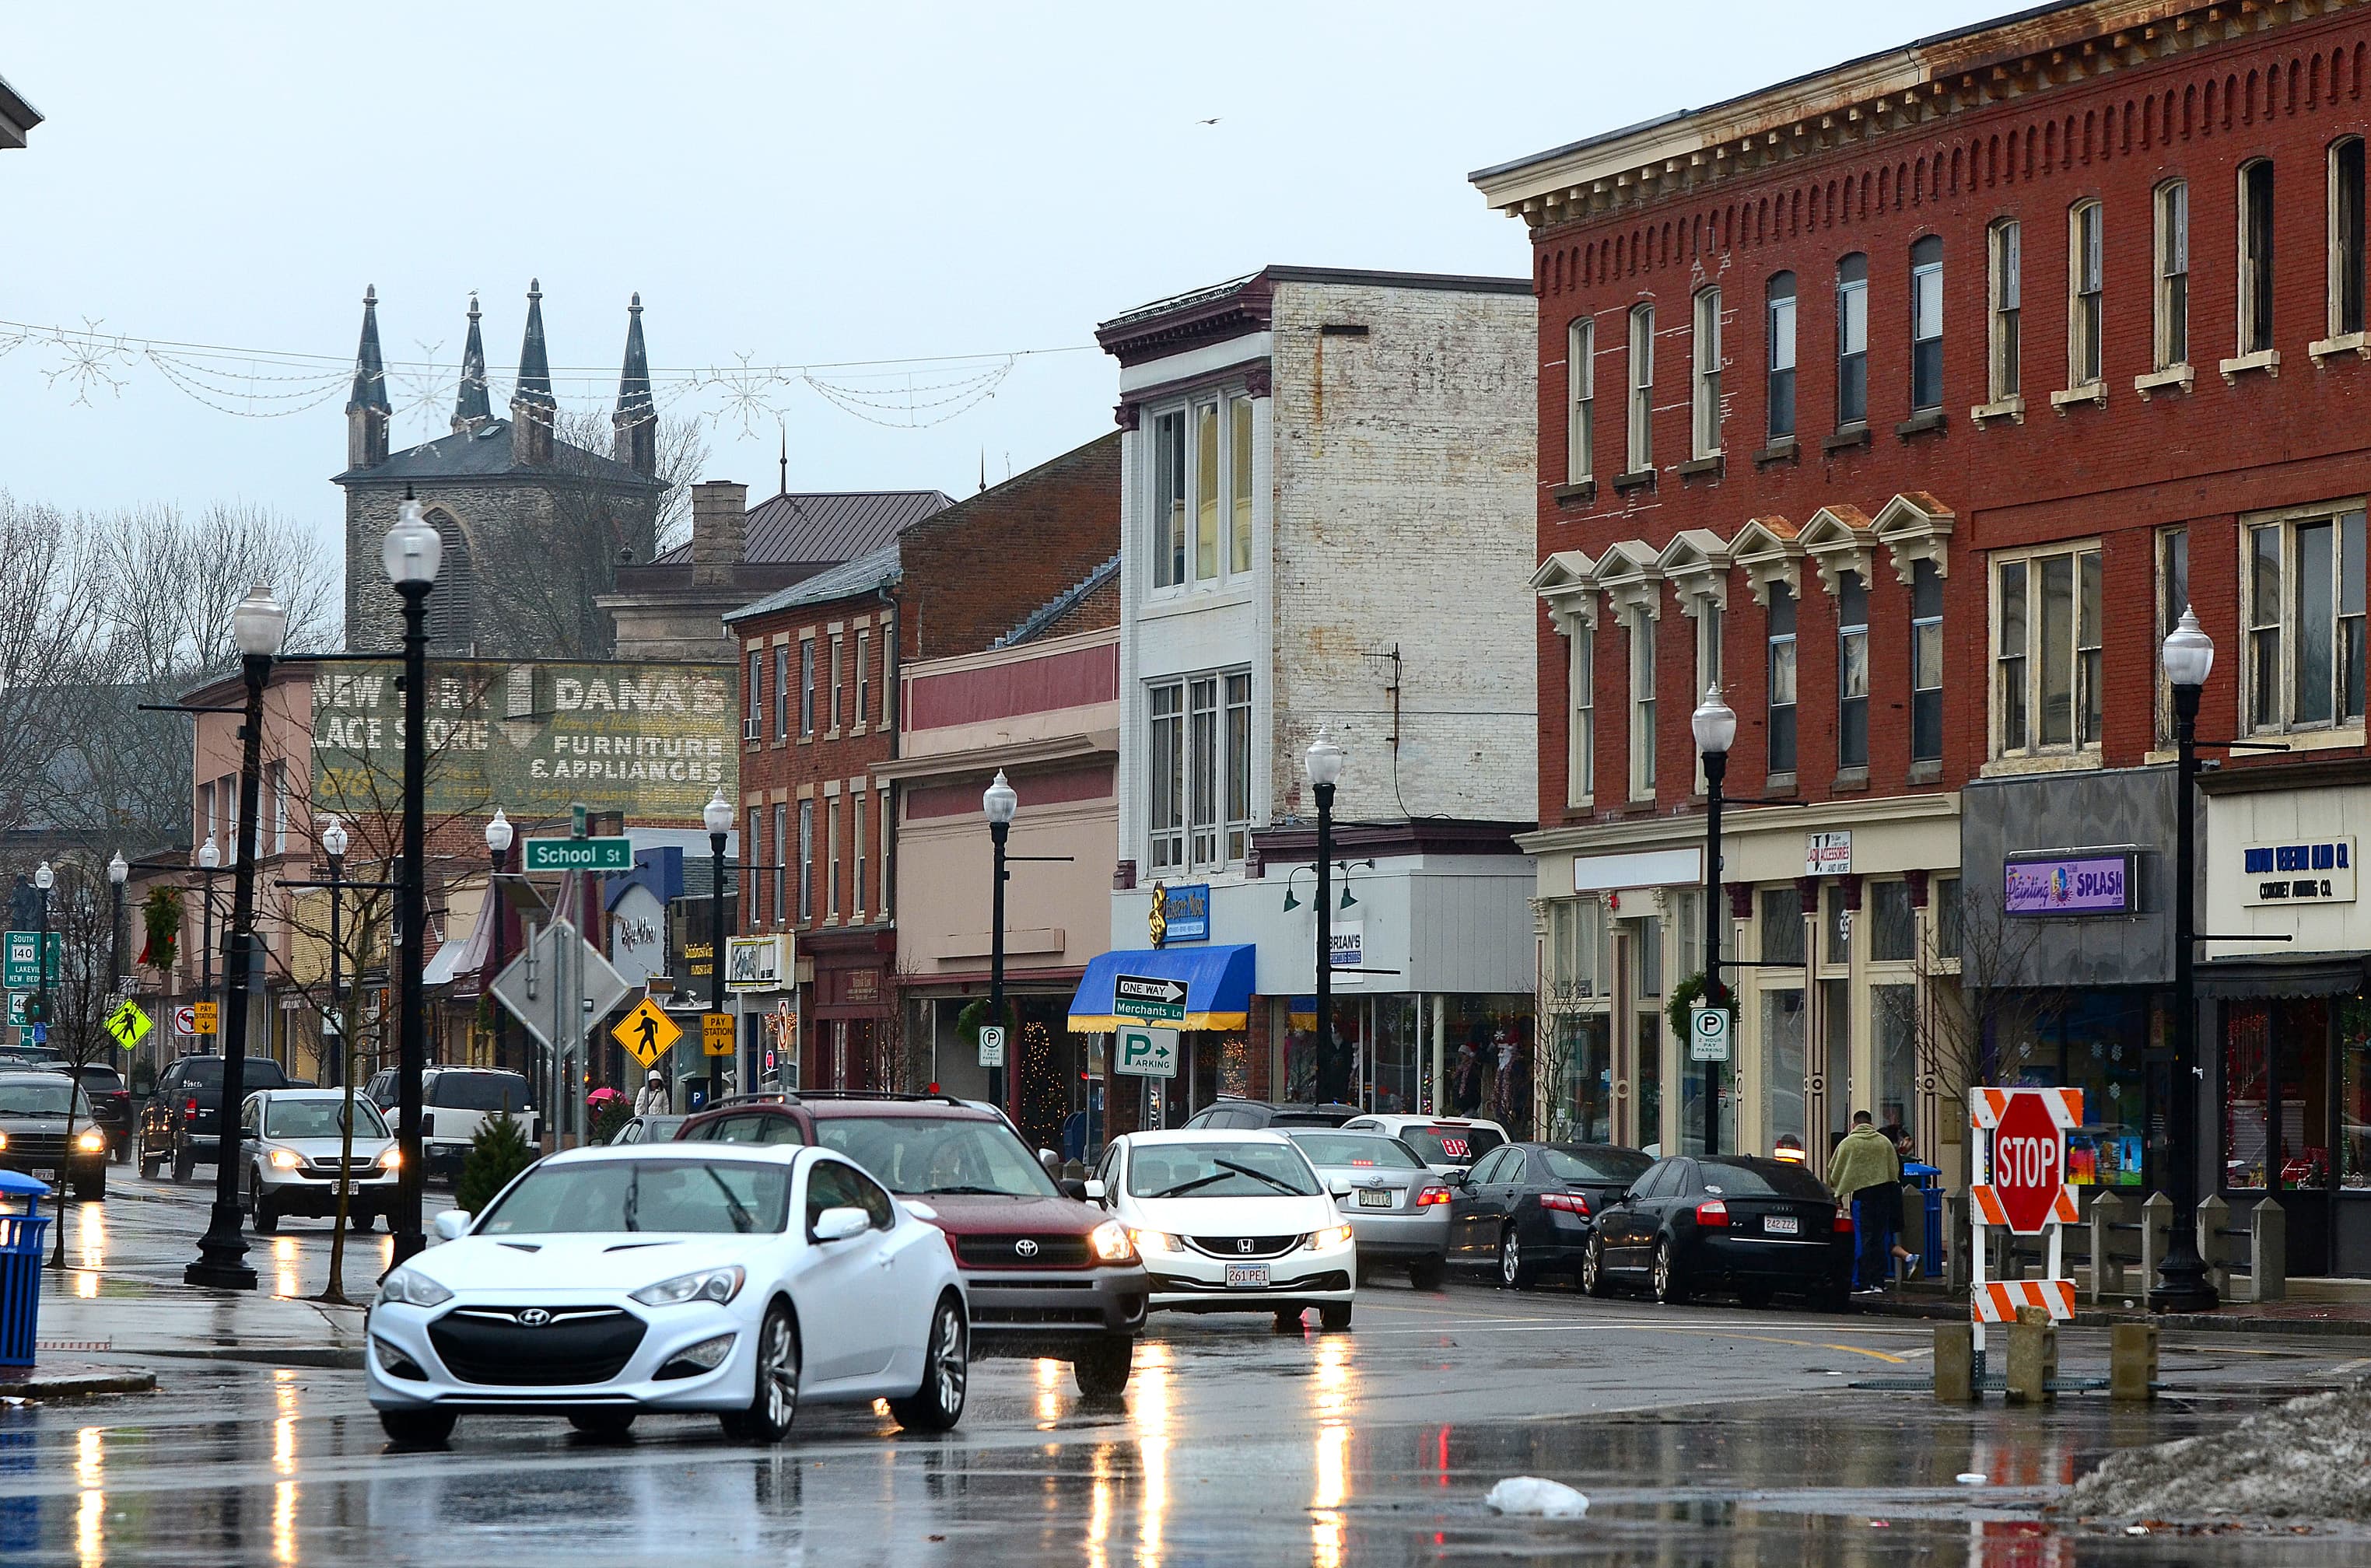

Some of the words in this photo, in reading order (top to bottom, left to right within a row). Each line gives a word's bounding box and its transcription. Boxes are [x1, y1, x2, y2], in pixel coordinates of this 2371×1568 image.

[311, 675, 383, 707] NEW
[555, 676, 728, 711] DANA'S
[311, 716, 381, 749] LACE
[554, 736, 723, 757] FURNITURE
[531, 759, 549, 779] &
[553, 759, 723, 782] APPLIANCES
[538, 846, 596, 863] School
[607, 849, 621, 862] St
[1820, 846, 1849, 861] ACCESSORIES
[2076, 870, 2122, 897] SPLASH
[14, 949, 32, 958] 140
[1123, 982, 1142, 993] ONE
[1146, 985, 1165, 996] WAY
[1117, 1003, 1166, 1016] Merchants
[711, 1017, 726, 1026] PAY
[1704, 1016, 1718, 1031] P
[704, 1027, 733, 1036] STATION
[988, 1032, 996, 1044] P
[694, 1092, 701, 1103] P
[1999, 1136, 2056, 1188] STOP
[1767, 1219, 1780, 1229] 242
[1229, 1270, 1246, 1281] 261
[1249, 1270, 1267, 1281] PE1
